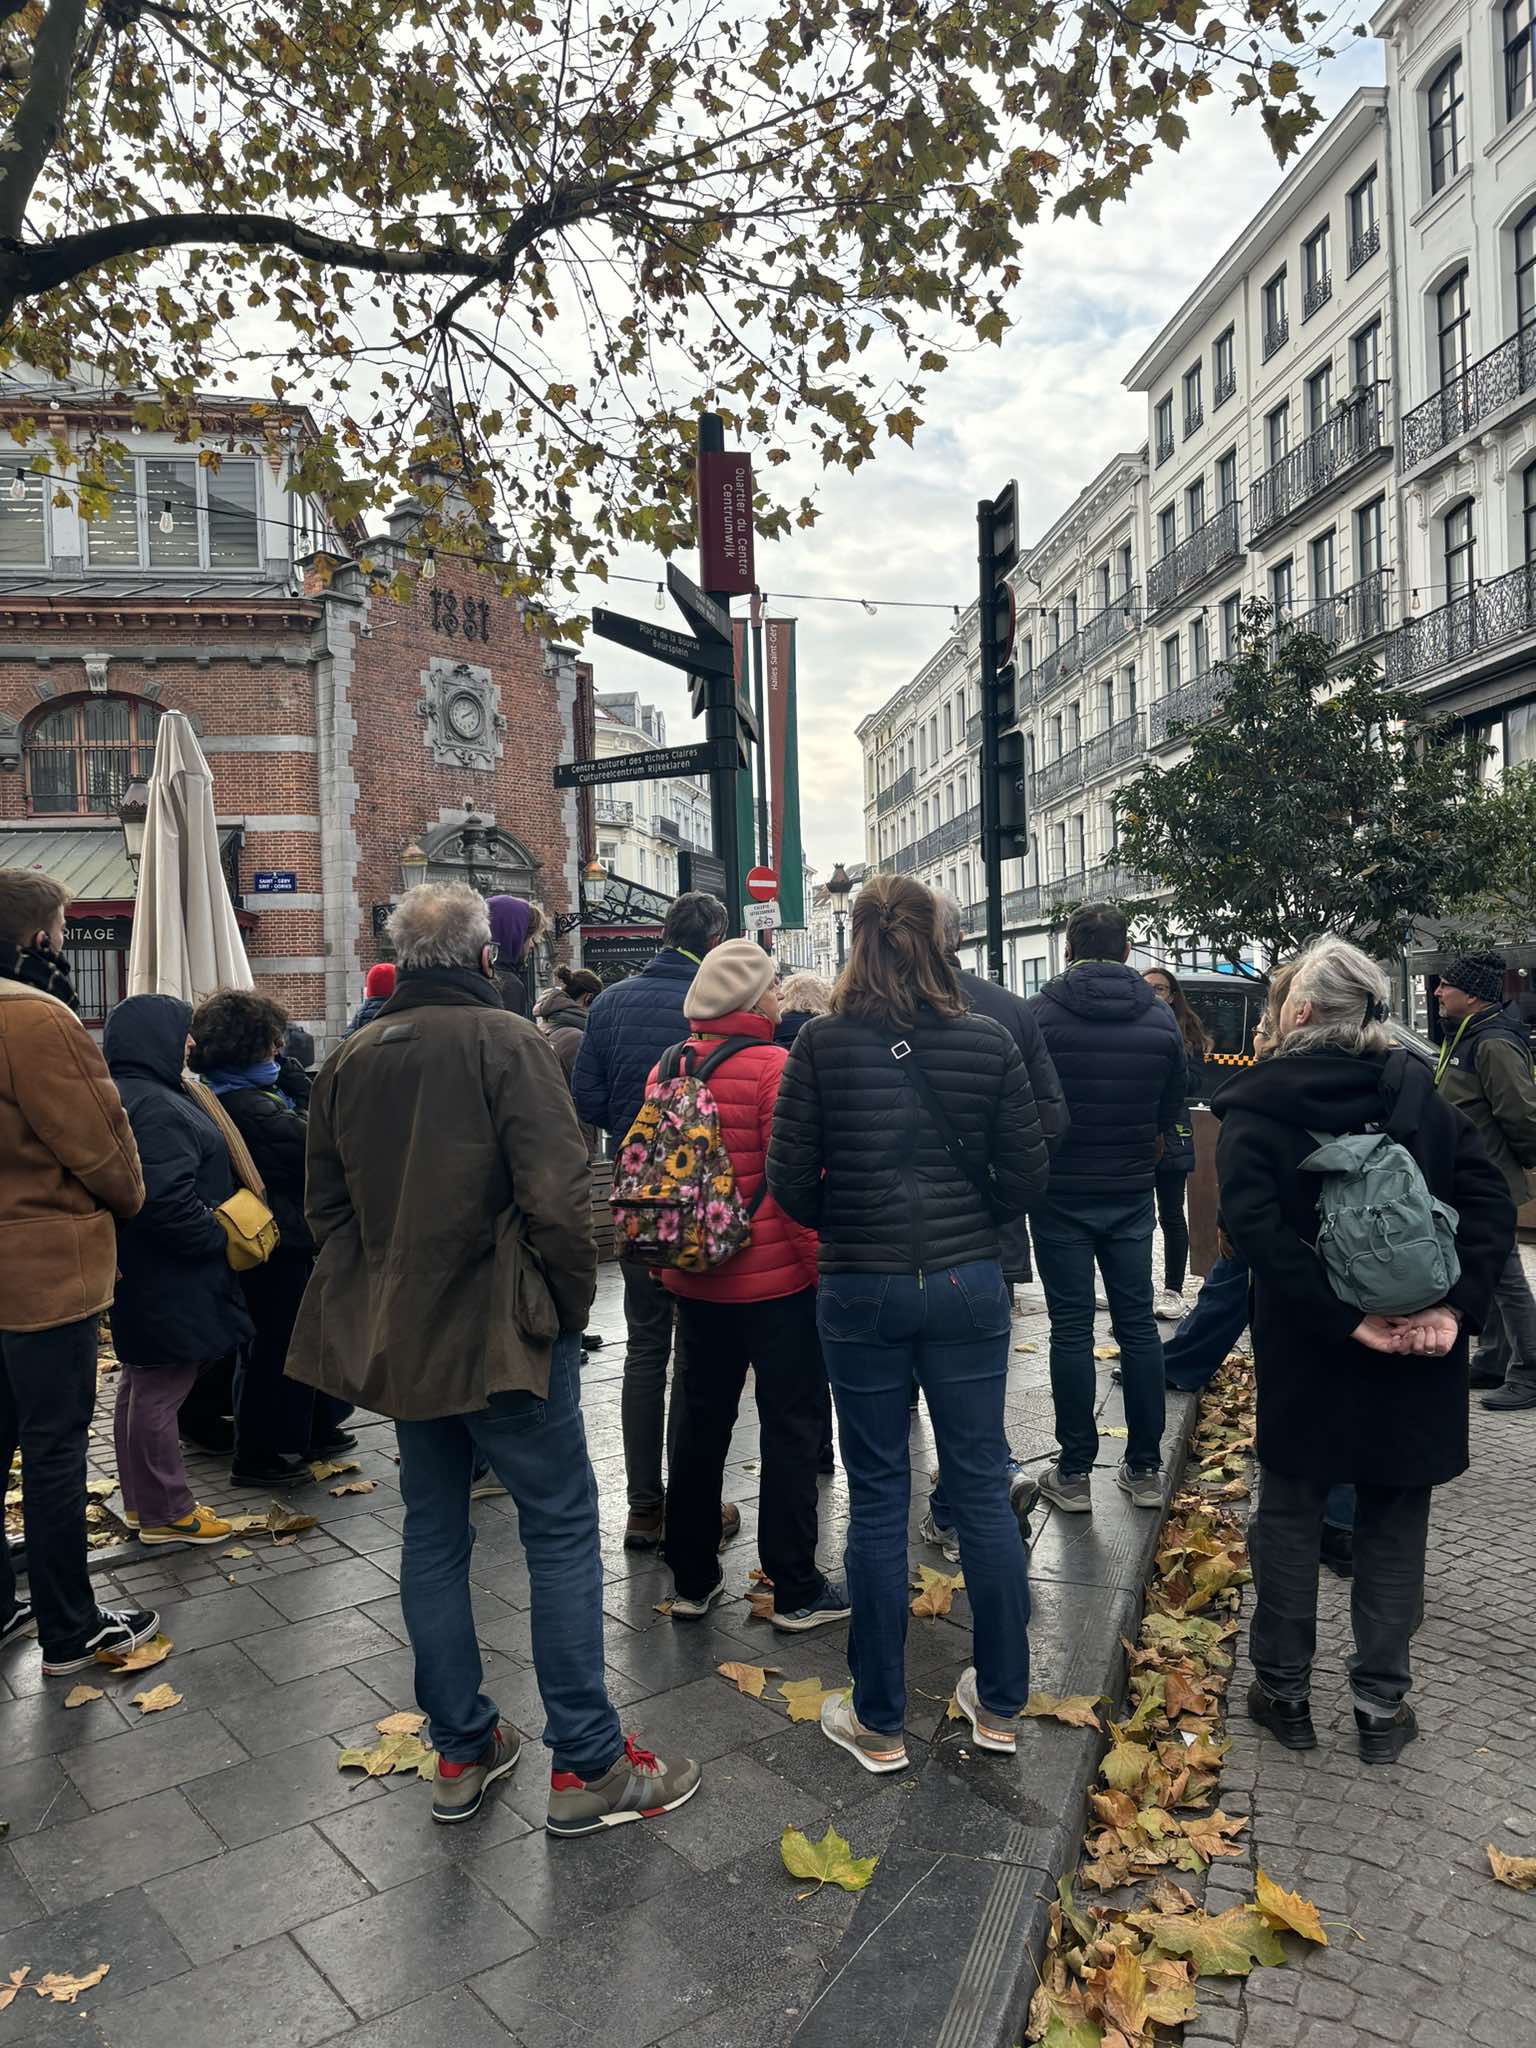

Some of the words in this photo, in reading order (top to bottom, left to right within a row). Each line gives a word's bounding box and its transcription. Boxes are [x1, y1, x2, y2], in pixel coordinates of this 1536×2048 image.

[735, 467, 746, 513] Quartier
[723, 483, 735, 558] Centrumwijk
[737, 518, 747, 532] du
[738, 538, 748, 576] Centre
[430, 588, 489, 643] 1881
[571, 764, 595, 774] Centre
[629, 758, 642, 766] des
[645, 753, 669, 763] Riches
[671, 748, 698, 759] Claires
[578, 766, 645, 783] Cultureelcentrum
[647, 760, 690, 773] Rijkeklaren
[63, 928, 115, 940] RITAGE
